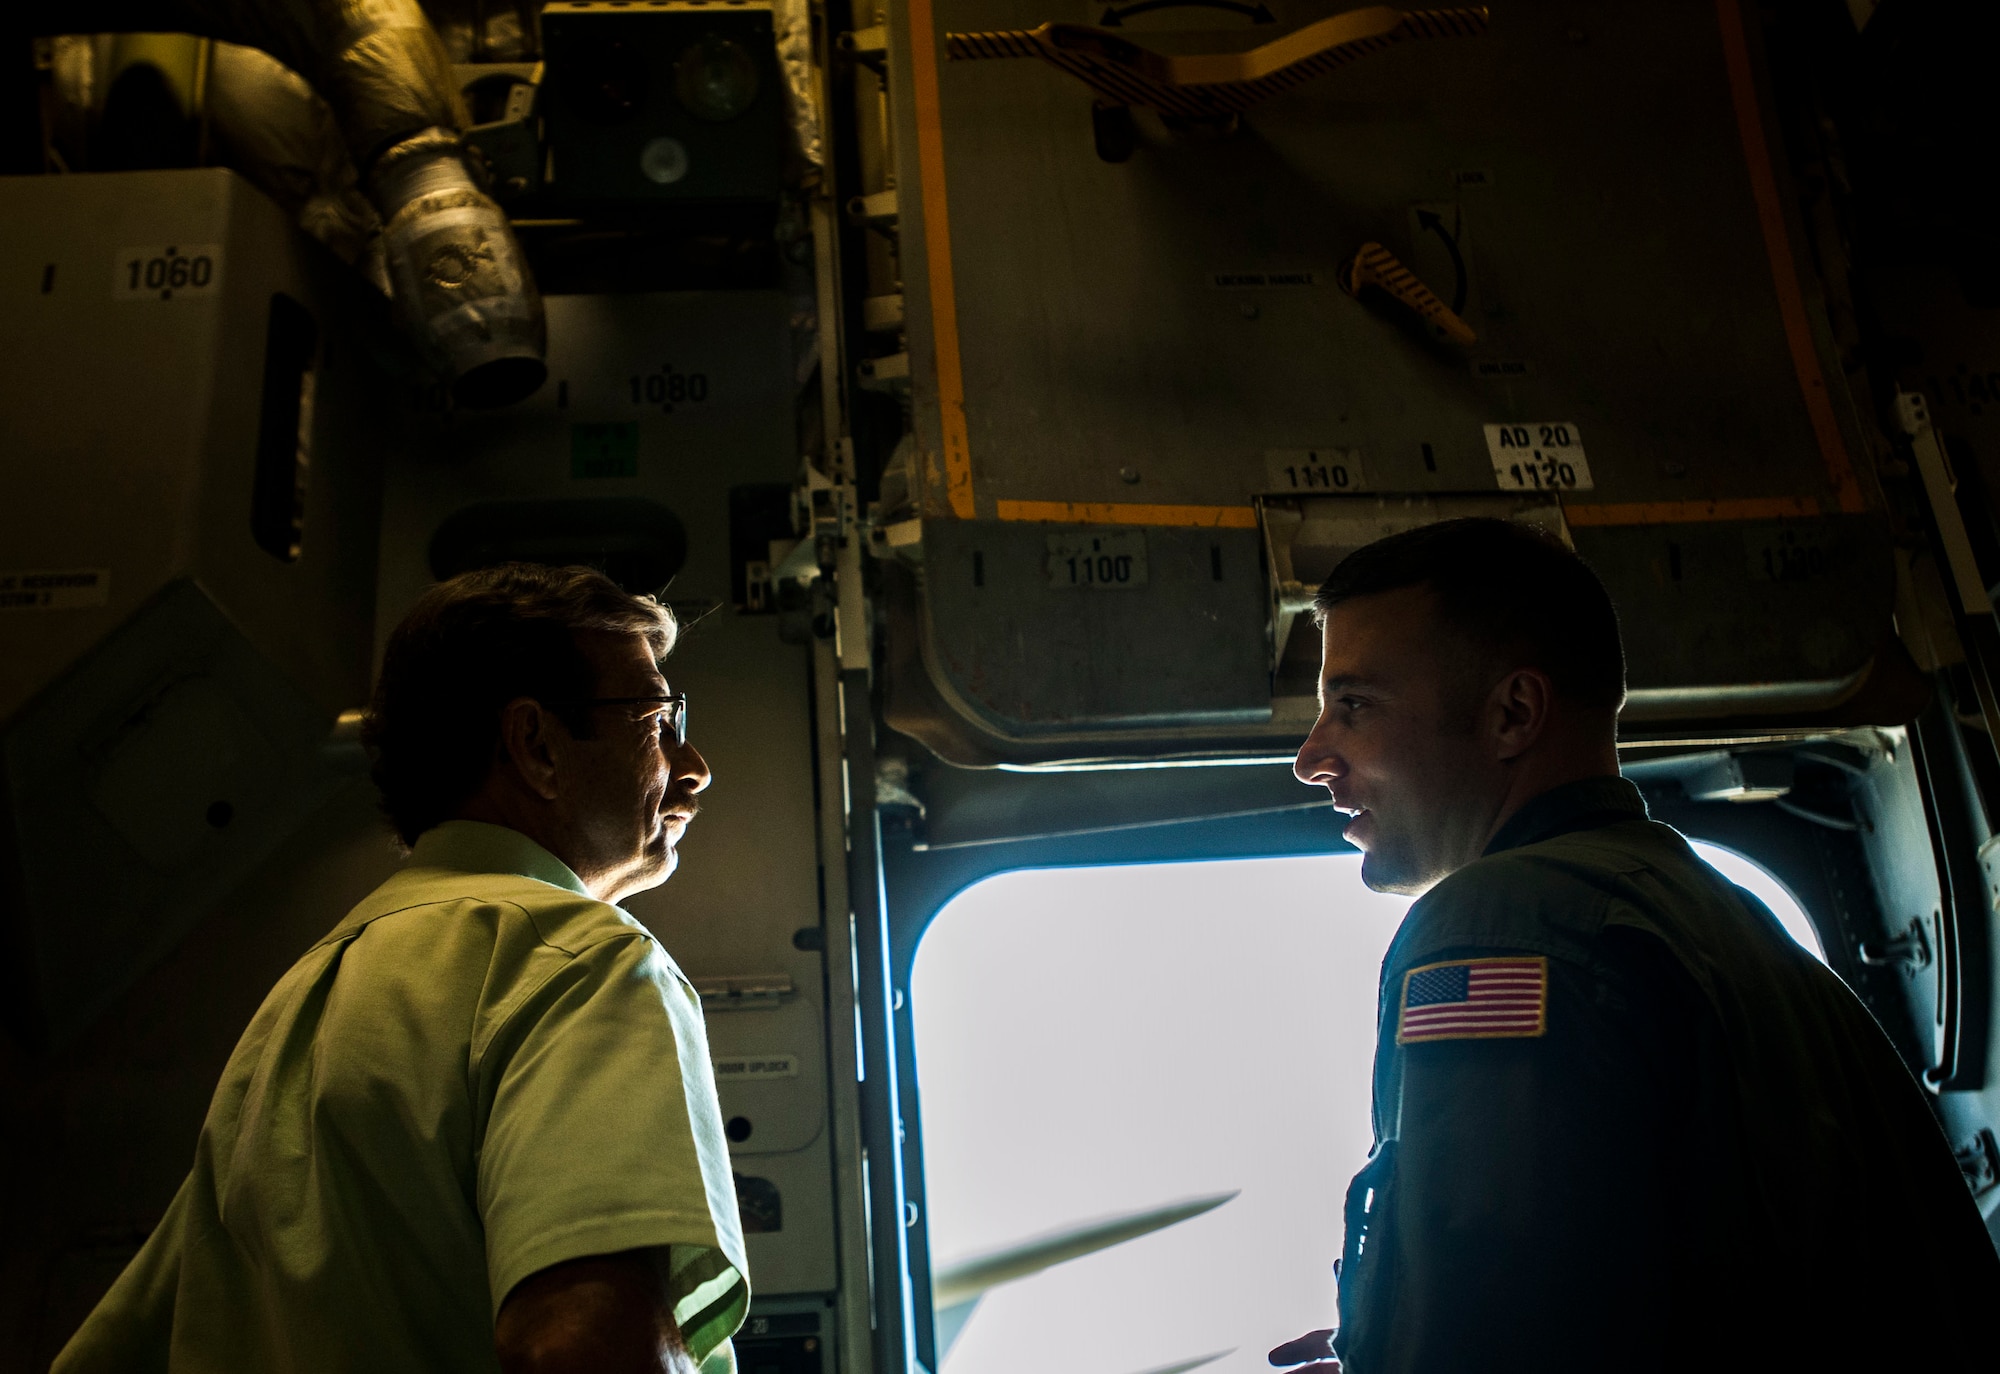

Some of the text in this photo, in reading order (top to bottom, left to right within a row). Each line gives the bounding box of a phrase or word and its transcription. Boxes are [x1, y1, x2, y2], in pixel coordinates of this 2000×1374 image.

[128, 256, 212, 289] 1060
[629, 372, 707, 404] 1080
[1500, 426, 1570, 447] AD 20
[1286, 465, 1349, 487] 1110
[1511, 464, 1577, 487] 1120
[1067, 556, 1131, 583] 1100
